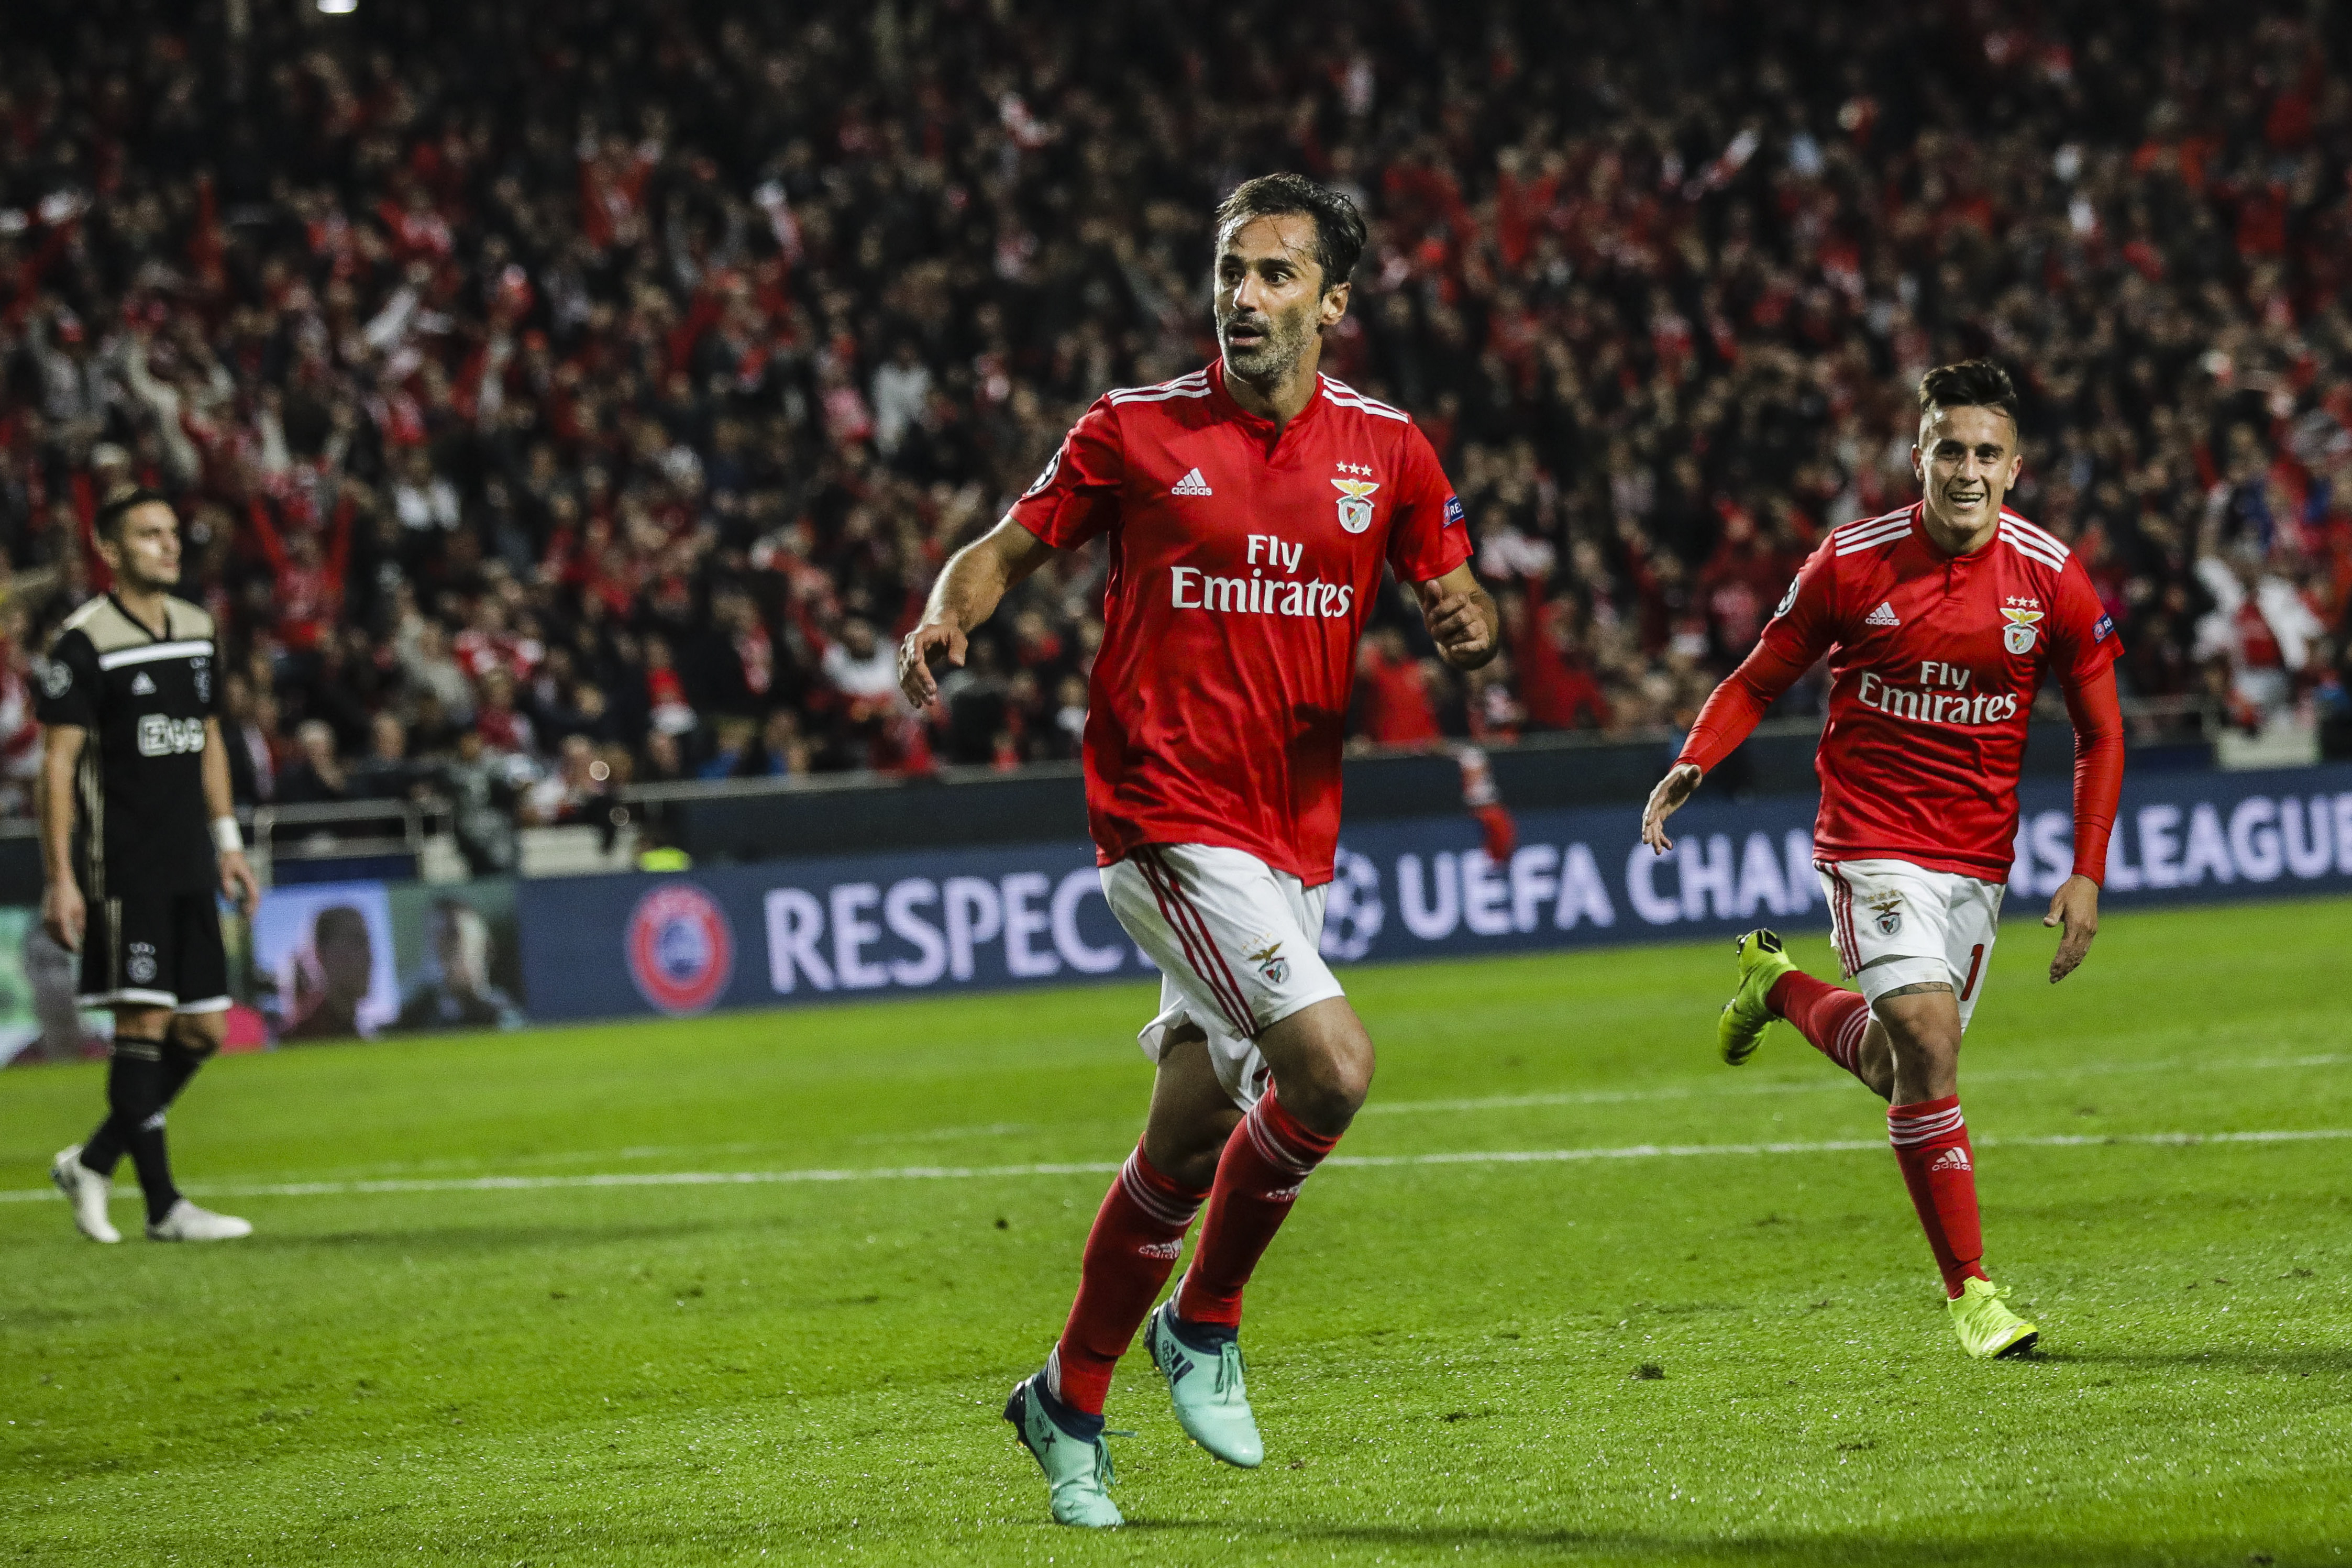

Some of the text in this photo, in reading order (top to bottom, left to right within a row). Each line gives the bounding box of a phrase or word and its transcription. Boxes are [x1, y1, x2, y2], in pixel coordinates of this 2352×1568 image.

[1171, 486, 1212, 496] adidas
[1247, 534, 1303, 574] Fly
[1171, 566, 1354, 619] Emirates
[1865, 616, 1901, 626] adidas
[1920, 660, 1970, 690] Fly
[1858, 670, 2018, 724] Emirates
[1396, 842, 1615, 941] UEFA
[762, 867, 1155, 995] RESPEC
[1931, 1160, 1972, 1172] adidas
